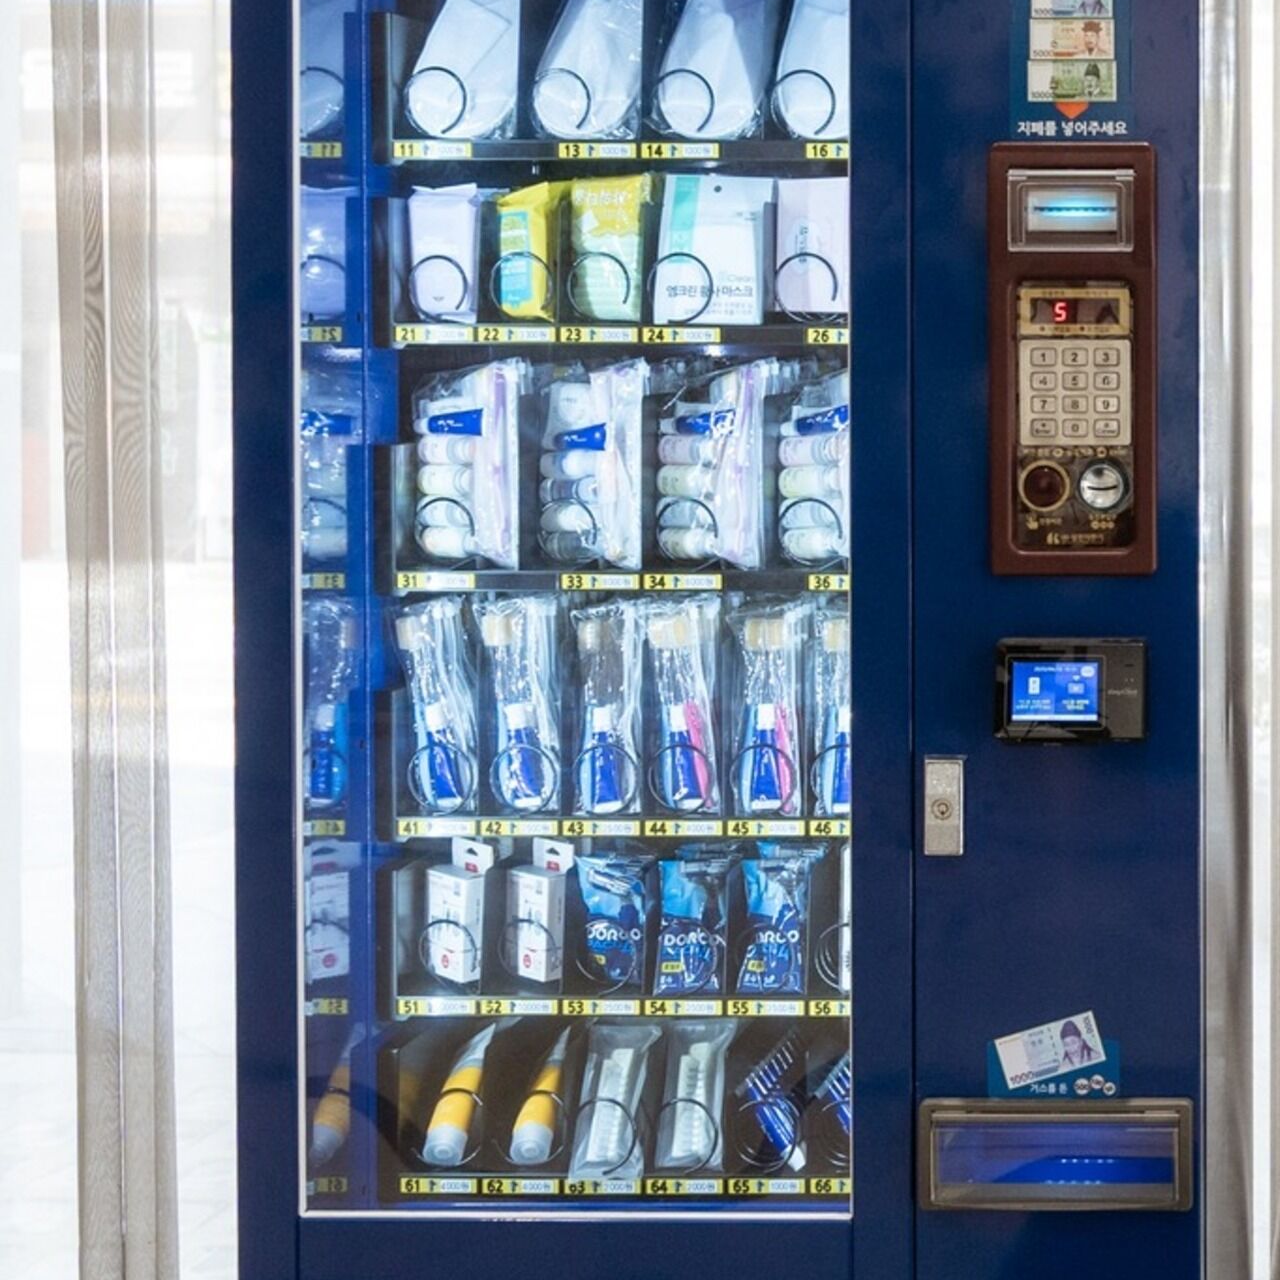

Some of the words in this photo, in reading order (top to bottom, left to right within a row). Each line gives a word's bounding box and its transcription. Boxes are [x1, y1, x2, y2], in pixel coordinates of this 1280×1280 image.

[1017, 121, 1058, 136] 지폐를
[1061, 121, 1128, 136] 넣어주세요
[400, 144, 414, 156] 11
[564, 144, 580, 157] 13
[647, 144, 663, 157] 14
[812, 144, 828, 157] 16
[401, 328, 416, 340] 21
[483, 328, 499, 341] 22
[565, 328, 582, 341] 23
[647, 328, 664, 341] 24
[812, 328, 829, 341] 26
[402, 574, 417, 587] 31
[567, 575, 583, 588] 33
[650, 575, 666, 588] 34
[814, 575, 830, 588] 36
[403, 822, 418, 834] 41
[485, 822, 501, 834] 42
[568, 822, 584, 834] 43
[650, 822, 667, 834] 44
[732, 822, 749, 834] 45
[815, 822, 832, 834] 46
[404, 1001, 418, 1013] 51
[485, 1001, 501, 1013] 52
[568, 1001, 584, 1013] 53
[650, 1001, 667, 1013] 54
[732, 1001, 749, 1013] 55
[815, 1001, 832, 1013] 56
[404, 1179, 420, 1192] 61
[487, 1179, 503, 1192] 62
[651, 1179, 668, 1192] 64
[732, 1179, 749, 1192] 65
[815, 1179, 832, 1192] 66
